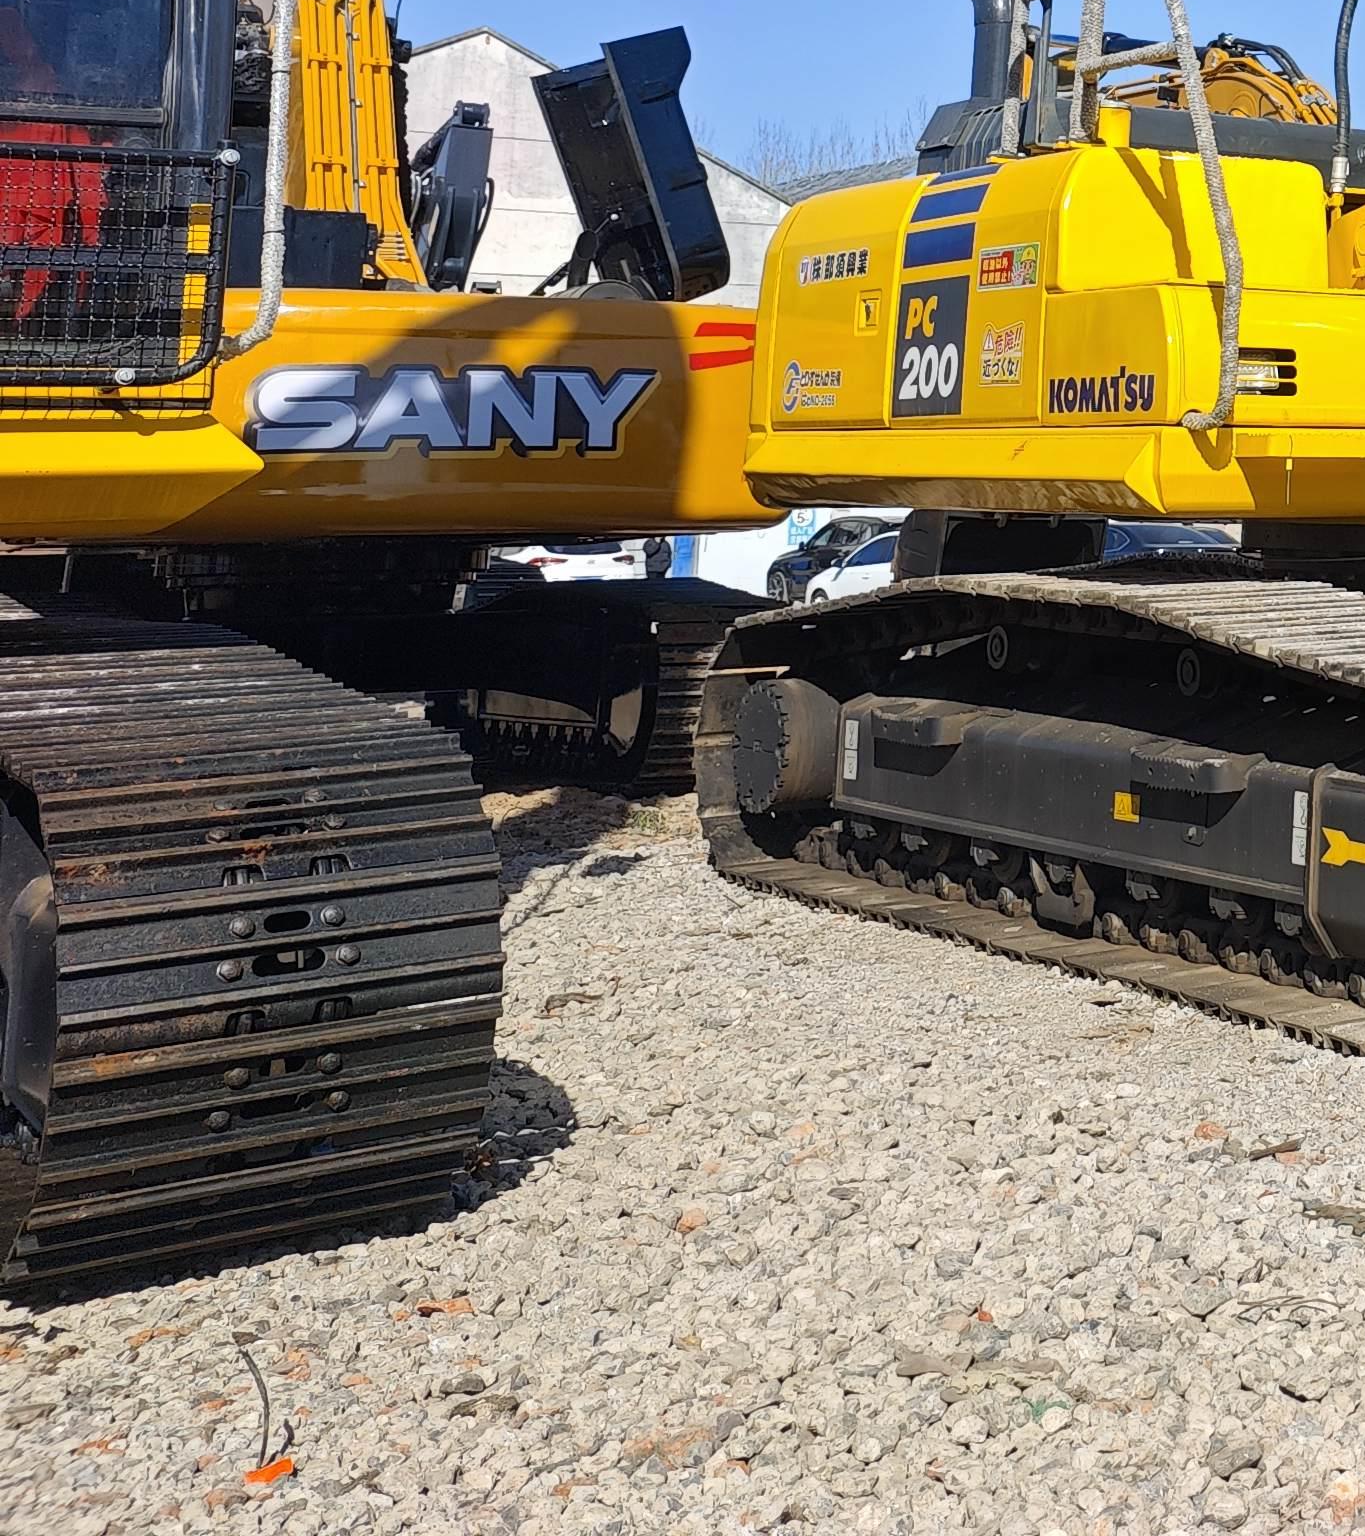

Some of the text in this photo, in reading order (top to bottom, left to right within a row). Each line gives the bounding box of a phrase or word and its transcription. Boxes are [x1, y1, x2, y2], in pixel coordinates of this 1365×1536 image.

[905, 296, 938, 340] PC
[898, 342, 959, 401] 200
[1049, 366, 1155, 414] KOMATSU
[252, 367, 659, 453] SANY
